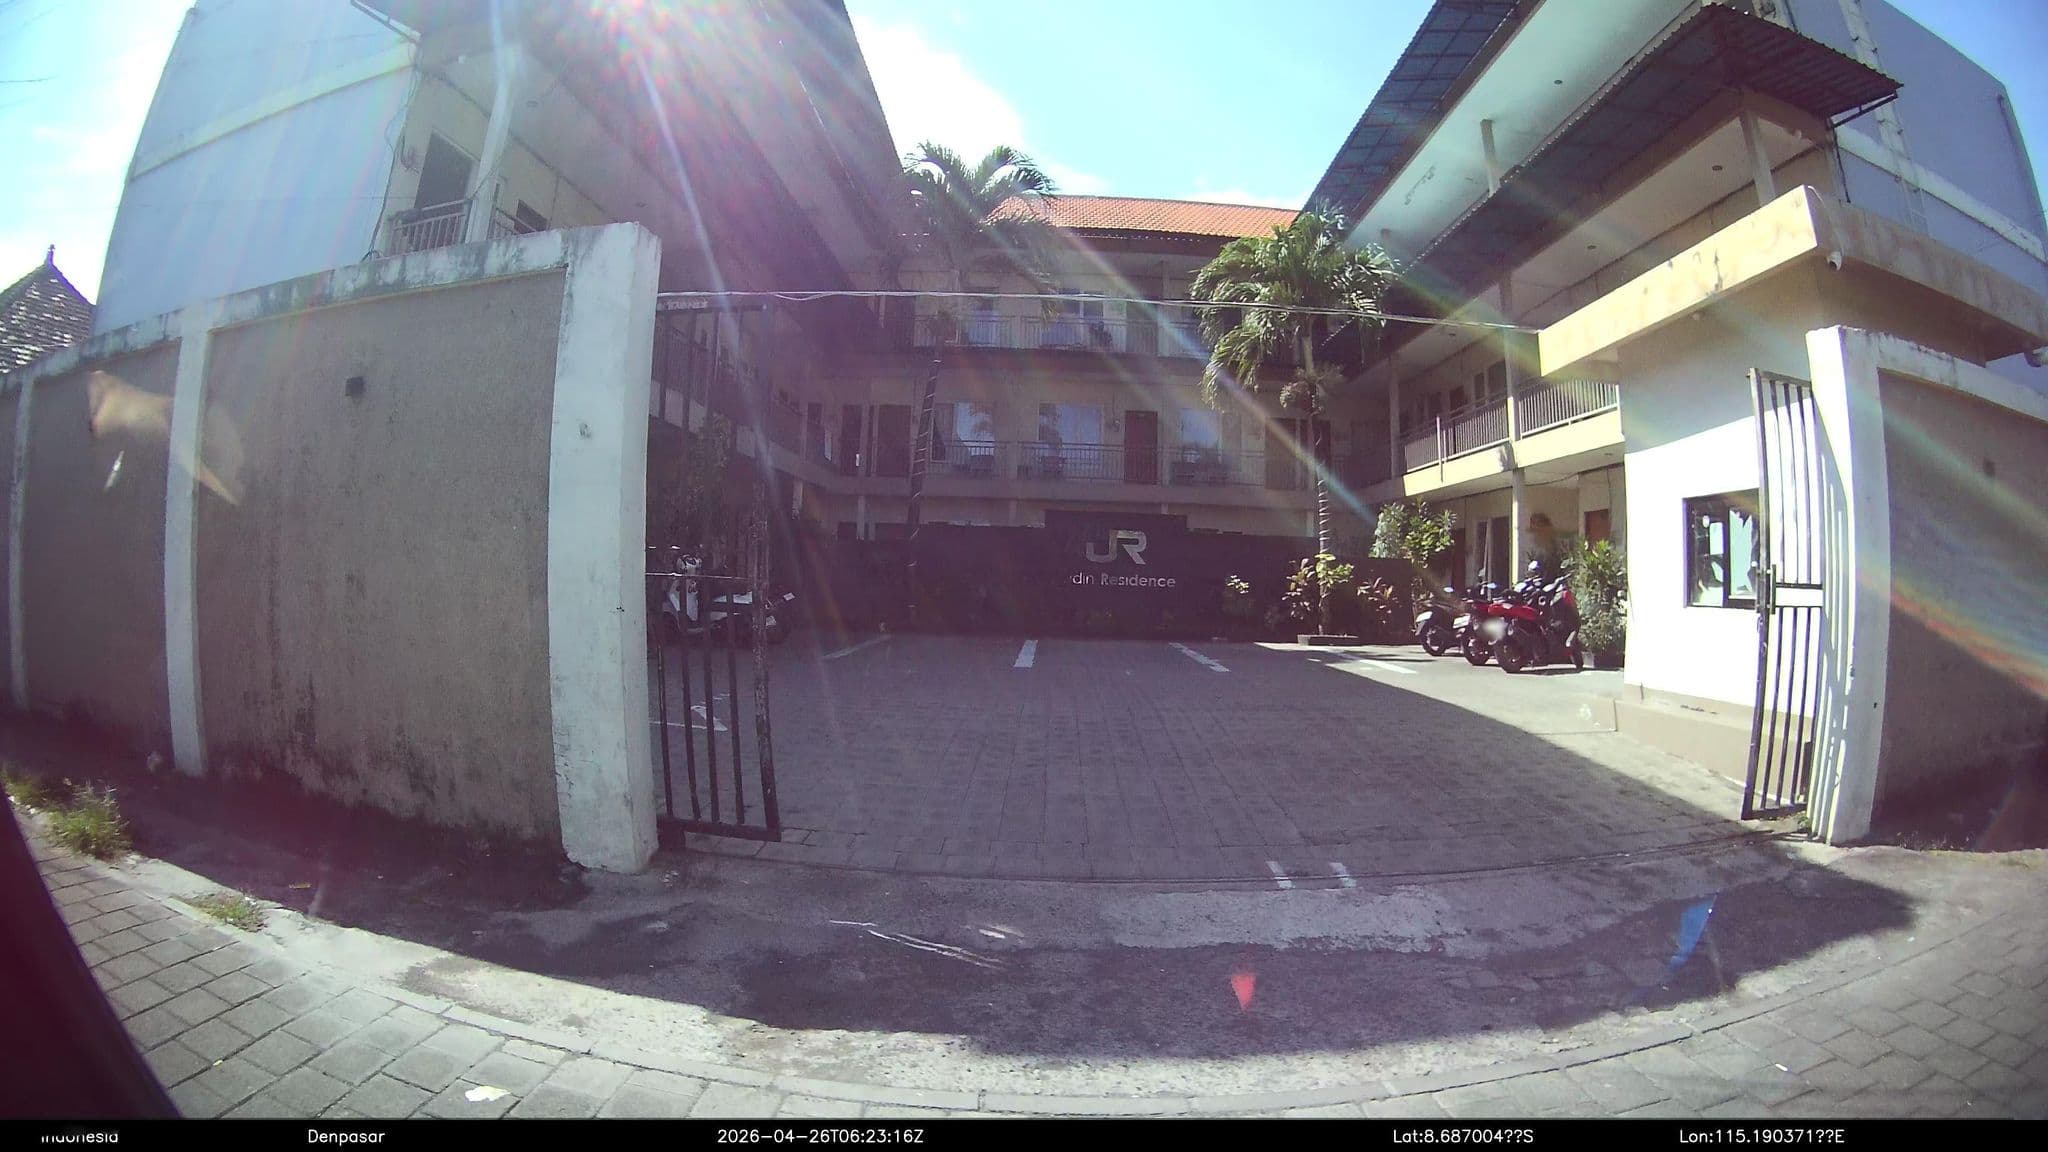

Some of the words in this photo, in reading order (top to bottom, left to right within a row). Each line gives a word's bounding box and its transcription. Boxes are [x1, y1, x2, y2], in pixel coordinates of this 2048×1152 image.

[1086, 529, 1147, 565] JR
[1069, 572, 1094, 585] din
[1101, 573, 1176, 588] Residence
